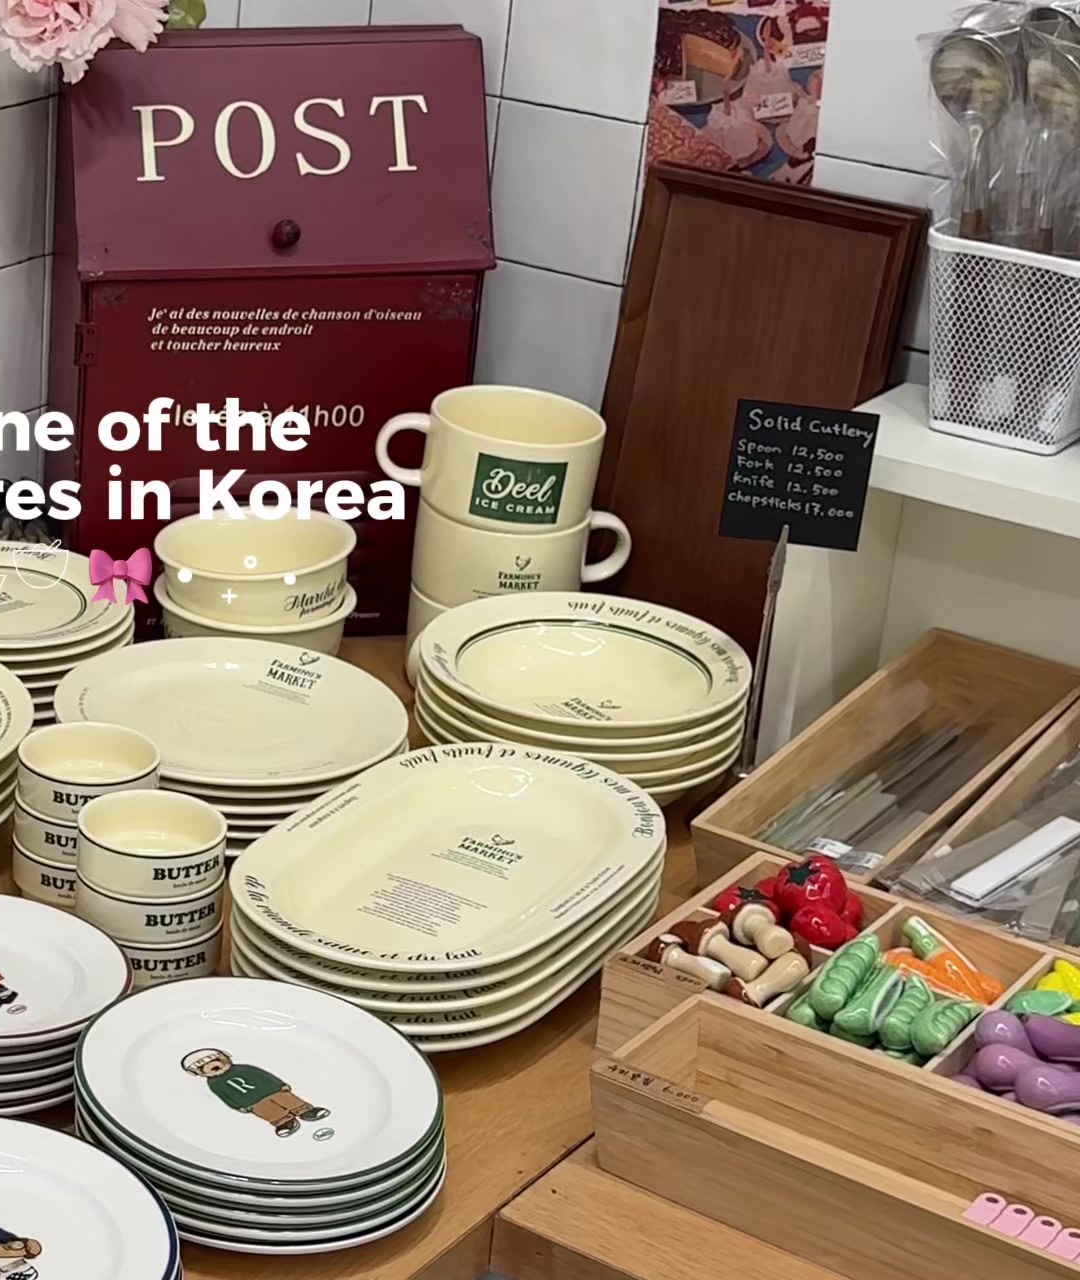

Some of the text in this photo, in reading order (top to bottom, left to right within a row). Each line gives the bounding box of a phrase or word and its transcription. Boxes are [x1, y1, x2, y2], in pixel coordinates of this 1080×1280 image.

[132, 94, 428, 182] POST
[170, 308, 183, 320] ai
[186, 308, 209, 320] des
[212, 308, 279, 320] nouvelles
[282, 308, 299, 320] de
[301, 308, 361, 320] chanson
[364, 308, 422, 321] d'oiseau
[152, 323, 313, 337] de beaucoup de endroit
[151, 340, 281, 351] et toucher heureux
[749, 408, 873, 449] Solid Cutlery
[737, 438, 845, 462] Spoon 12,500
[736, 455, 775, 471] Fork
[482, 467, 557, 503] Deel
[475, 497, 556, 515] ICE CREAM
[498, 580, 541, 591] MARKET
[267, 667, 317, 690] MARKET
[399, 748, 438, 771] frais
[442, 745, 493, 761] fruits
[52, 790, 103, 806] BUTT
[43, 831, 77, 849] BUT
[457, 841, 518, 866] MARKET
[152, 854, 221, 881] BUTTER
[40, 873, 77, 892] BUT
[144, 902, 216, 928] BUTTER
[317, 937, 374, 959] saine
[406, 950, 440, 962] du
[444, 946, 483, 962] lait
[130, 950, 207, 971] BUTTER
[226, 1076, 256, 1094] R
